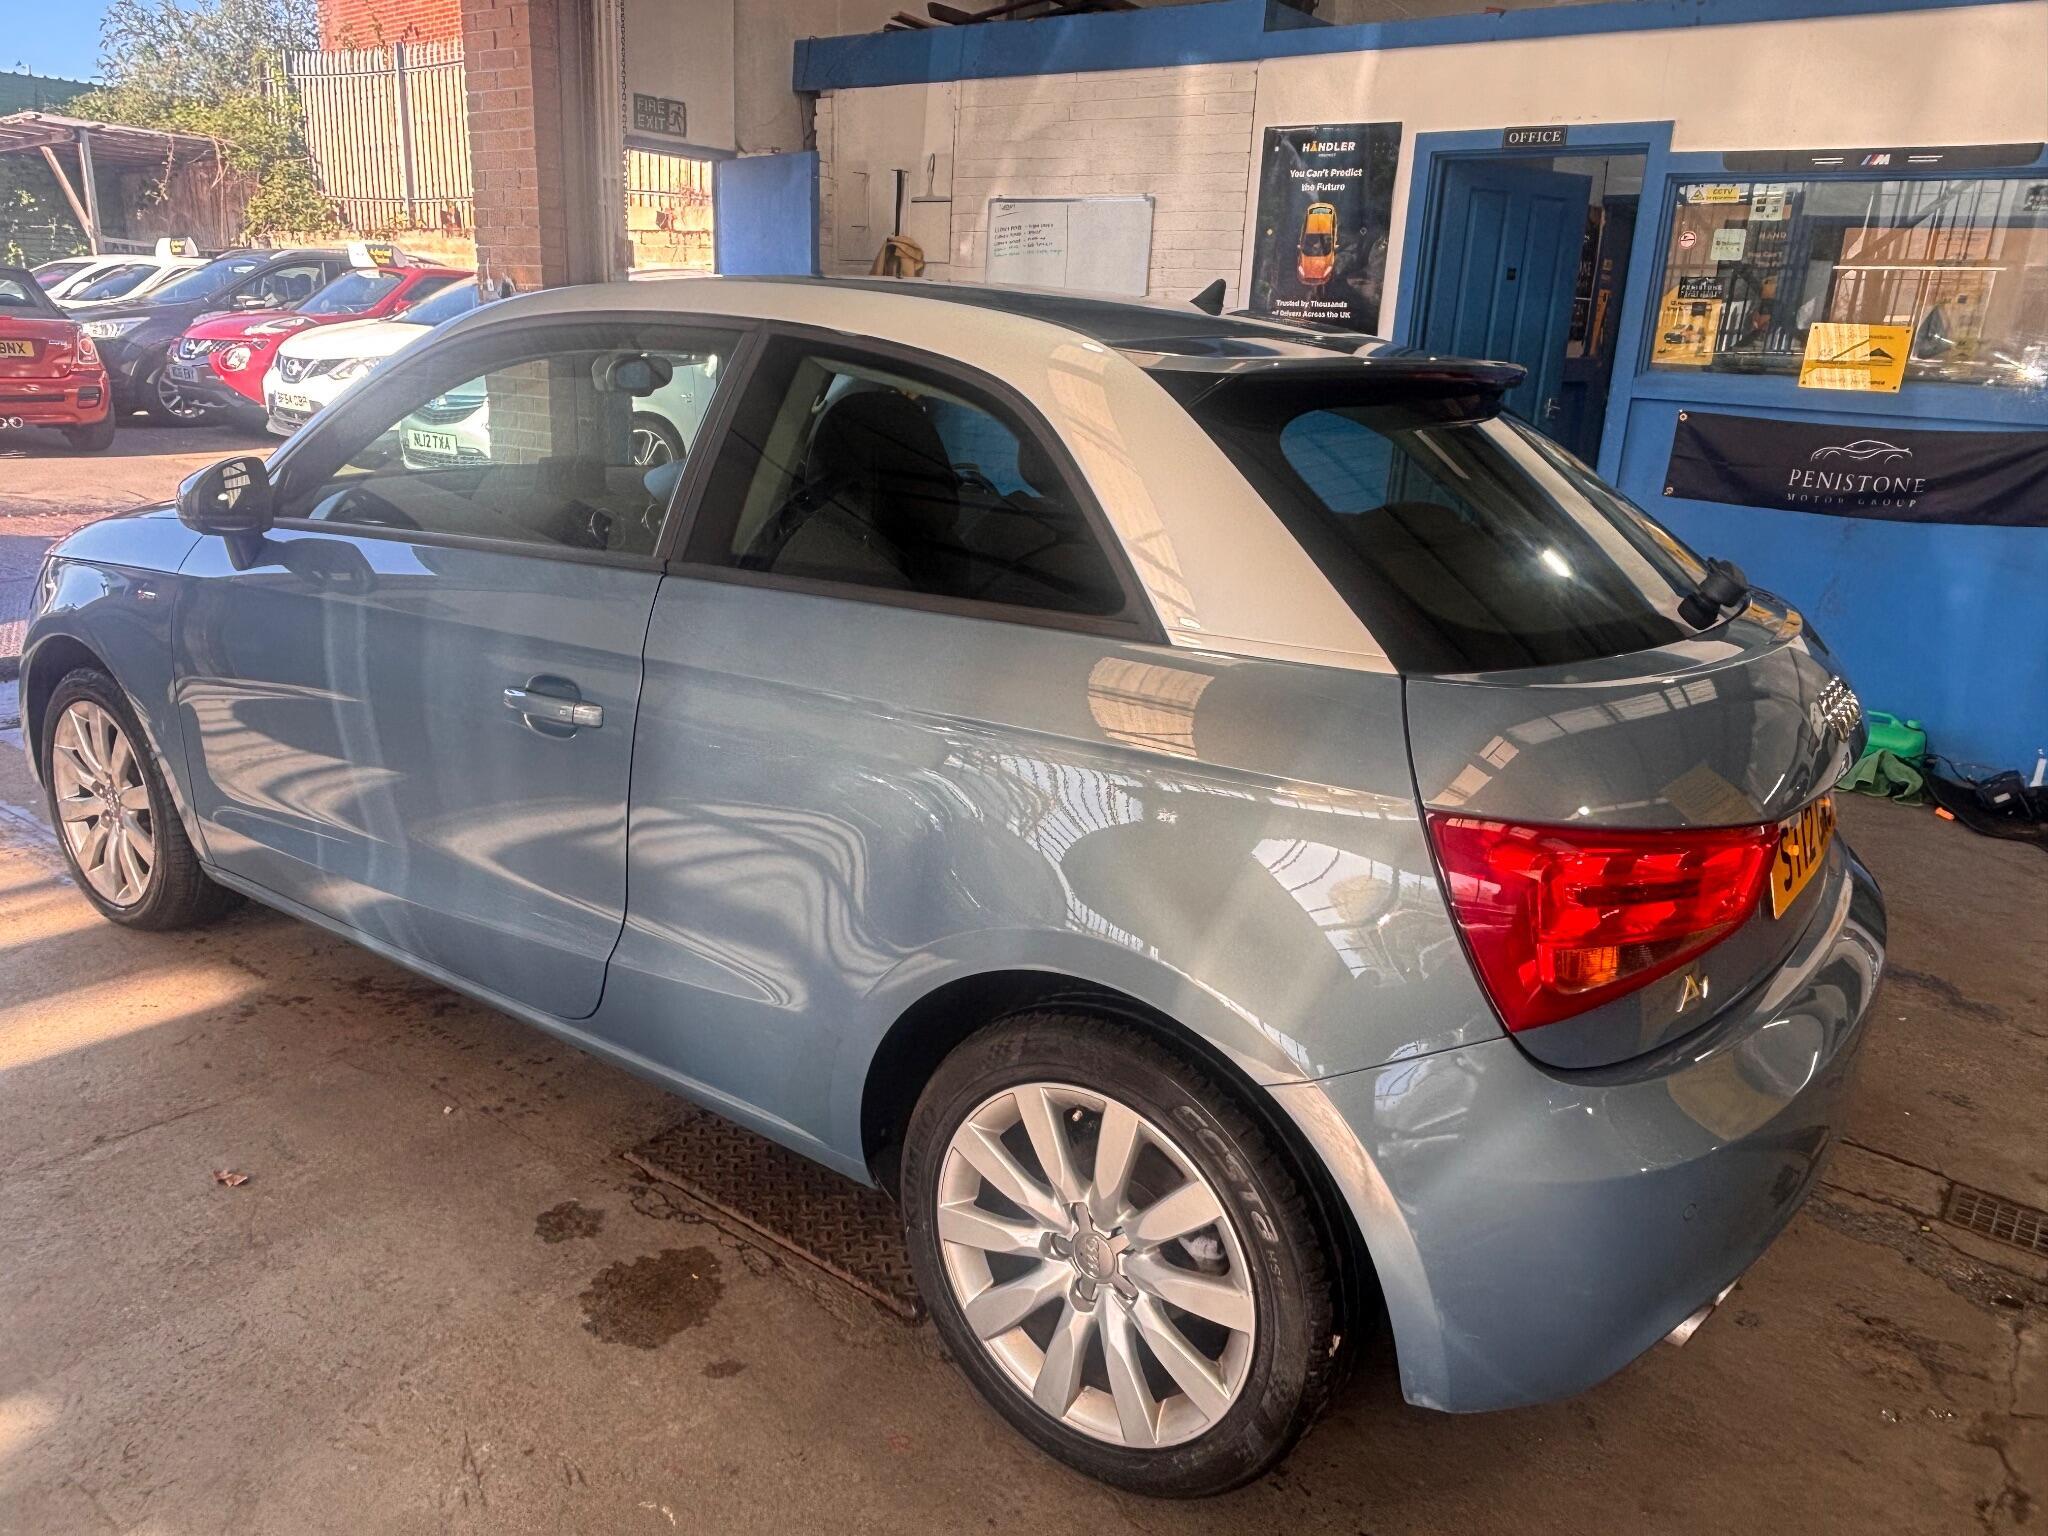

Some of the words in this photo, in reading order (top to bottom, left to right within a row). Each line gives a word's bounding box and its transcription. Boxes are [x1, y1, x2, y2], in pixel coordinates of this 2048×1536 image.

[637, 98, 664, 114] FIRE
[637, 113, 666, 130] EXIT
[1508, 131, 1561, 143] OFFICE
[1290, 169, 1305, 178] You
[1306, 168, 1329, 177] Can't
[1330, 168, 1363, 177] Predict
[1301, 182, 1315, 192] the
[1316, 182, 1346, 191] Future
[1276, 299, 1300, 308] Trusted
[1300, 300, 1310, 309] by
[1310, 300, 1348, 308] Thousands
[1339, 311, 1351, 319] UK
[1787, 468, 1926, 493] PENISTONE
[1785, 492, 1844, 504] MOTOR
[1857, 498, 1917, 508] GROUP
